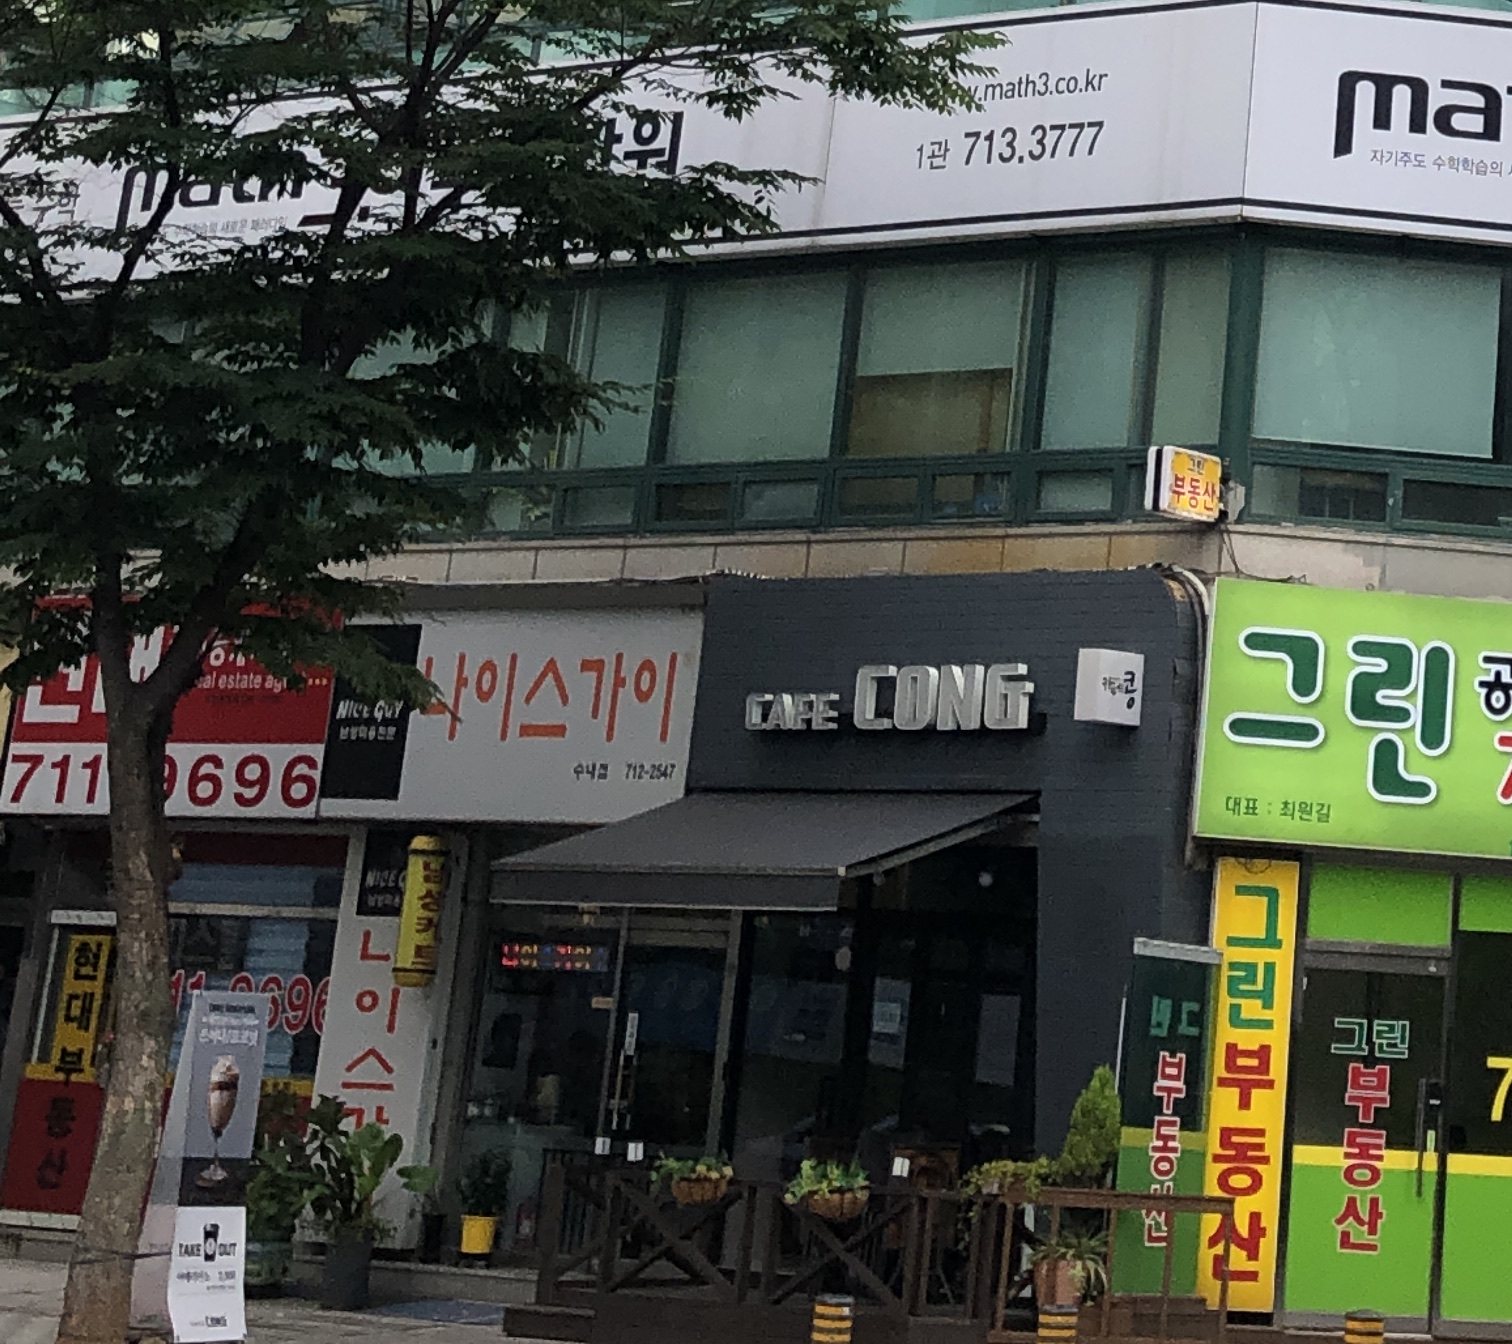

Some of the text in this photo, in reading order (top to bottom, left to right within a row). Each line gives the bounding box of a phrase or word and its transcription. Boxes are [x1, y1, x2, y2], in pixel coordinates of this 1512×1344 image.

[967, 68, 1109, 103] .math3.co.kr
[916, 120, 1105, 170] 1관 713.3777
[1370, 149, 1427, 170] 자기주도
[1431, 153, 1503, 178] 수학학습의
[1171, 473, 1217, 513] 부동산
[218, 672, 262, 689] estate
[745, 661, 1036, 733] CAFE CONG
[1223, 625, 1457, 804] 그린
[1225, 795, 1260, 817] 대표
[1331, 1016, 1411, 1059] 그린
[1333, 1062, 1391, 1253] 부동산
